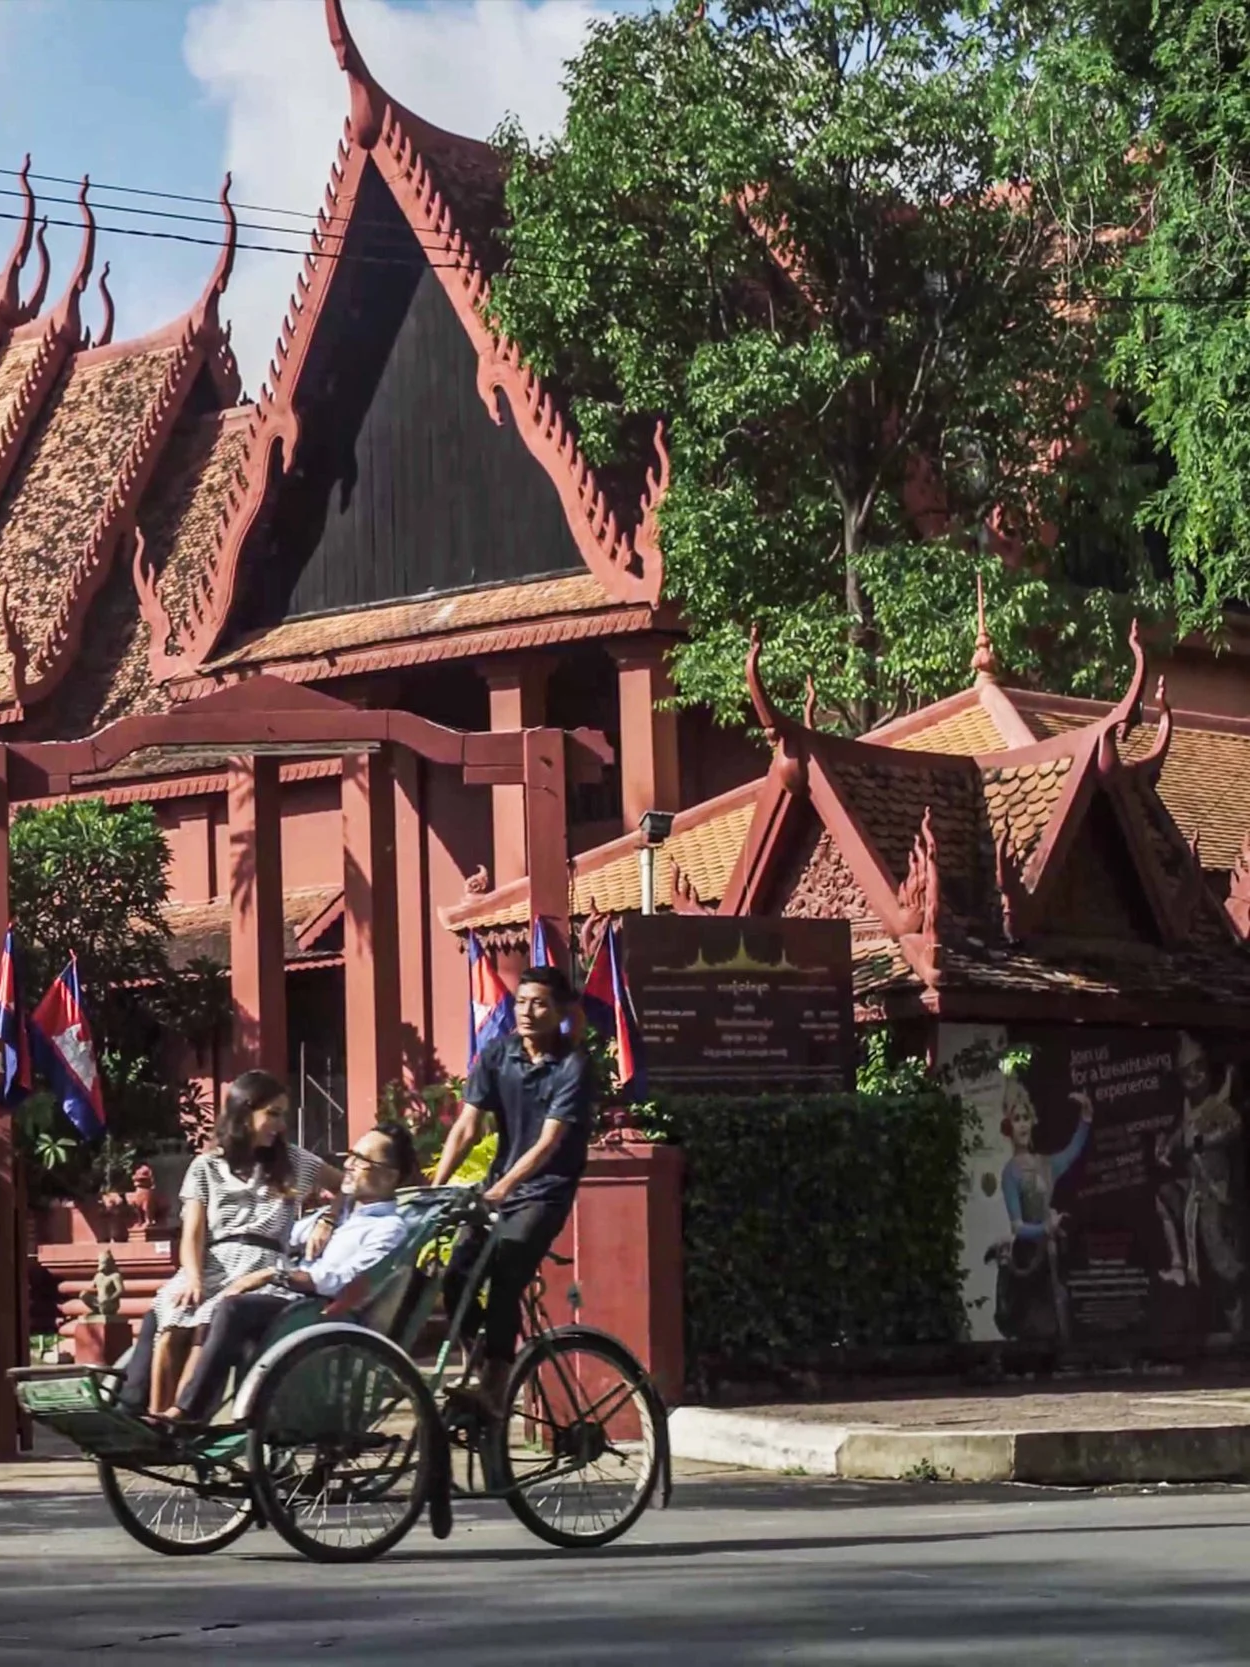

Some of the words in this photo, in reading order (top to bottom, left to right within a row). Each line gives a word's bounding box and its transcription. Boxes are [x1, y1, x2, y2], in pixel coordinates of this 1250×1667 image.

[1069, 1048, 1093, 1066] Join
[1070, 1067, 1087, 1085] for
[1090, 1068, 1099, 1082] a
[1099, 1053, 1172, 1080] breathtaking
[1095, 1076, 1160, 1103] experience
